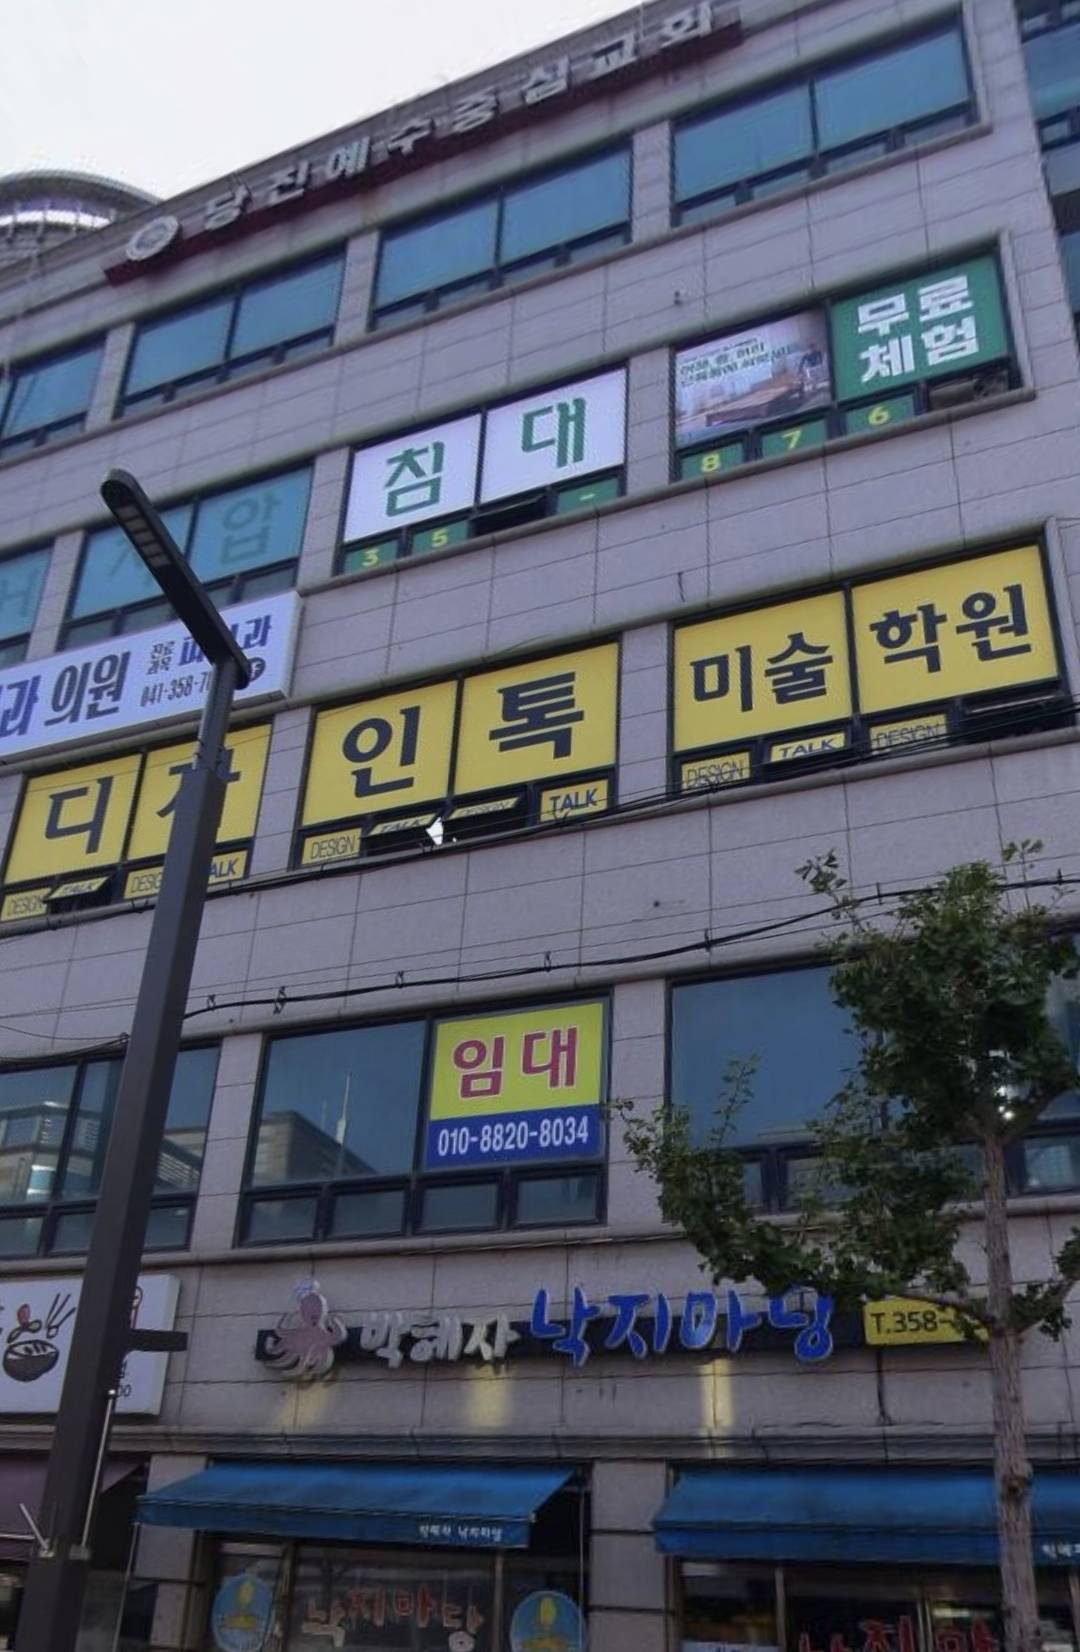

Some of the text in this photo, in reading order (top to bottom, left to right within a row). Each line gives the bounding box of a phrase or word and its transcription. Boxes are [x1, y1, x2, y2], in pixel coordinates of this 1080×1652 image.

[204, 4, 713, 231] 당진예수중심교회
[857, 275, 974, 337] 무료
[859, 315, 980, 383] 체험
[362, 549, 380, 567] 3
[431, 529, 449, 548] 5
[702, 453, 720, 472] 8
[783, 430, 803, 450] 7
[867, 405, 891, 427] 6
[384, 396, 587, 517] 침대
[44, 650, 132, 727] 의원
[130, 869, 163, 894] DESIG
[208, 858, 240, 879] ALK
[310, 835, 357, 860] DESIGN
[549, 788, 600, 815] TALK
[686, 759, 745, 791] DESIGN
[779, 736, 836, 758] TALK
[453, 1026, 579, 1101] 임대
[437, 1115, 590, 1158] 010-8820-8034
[870, 1309, 956, 1336] T.358-
